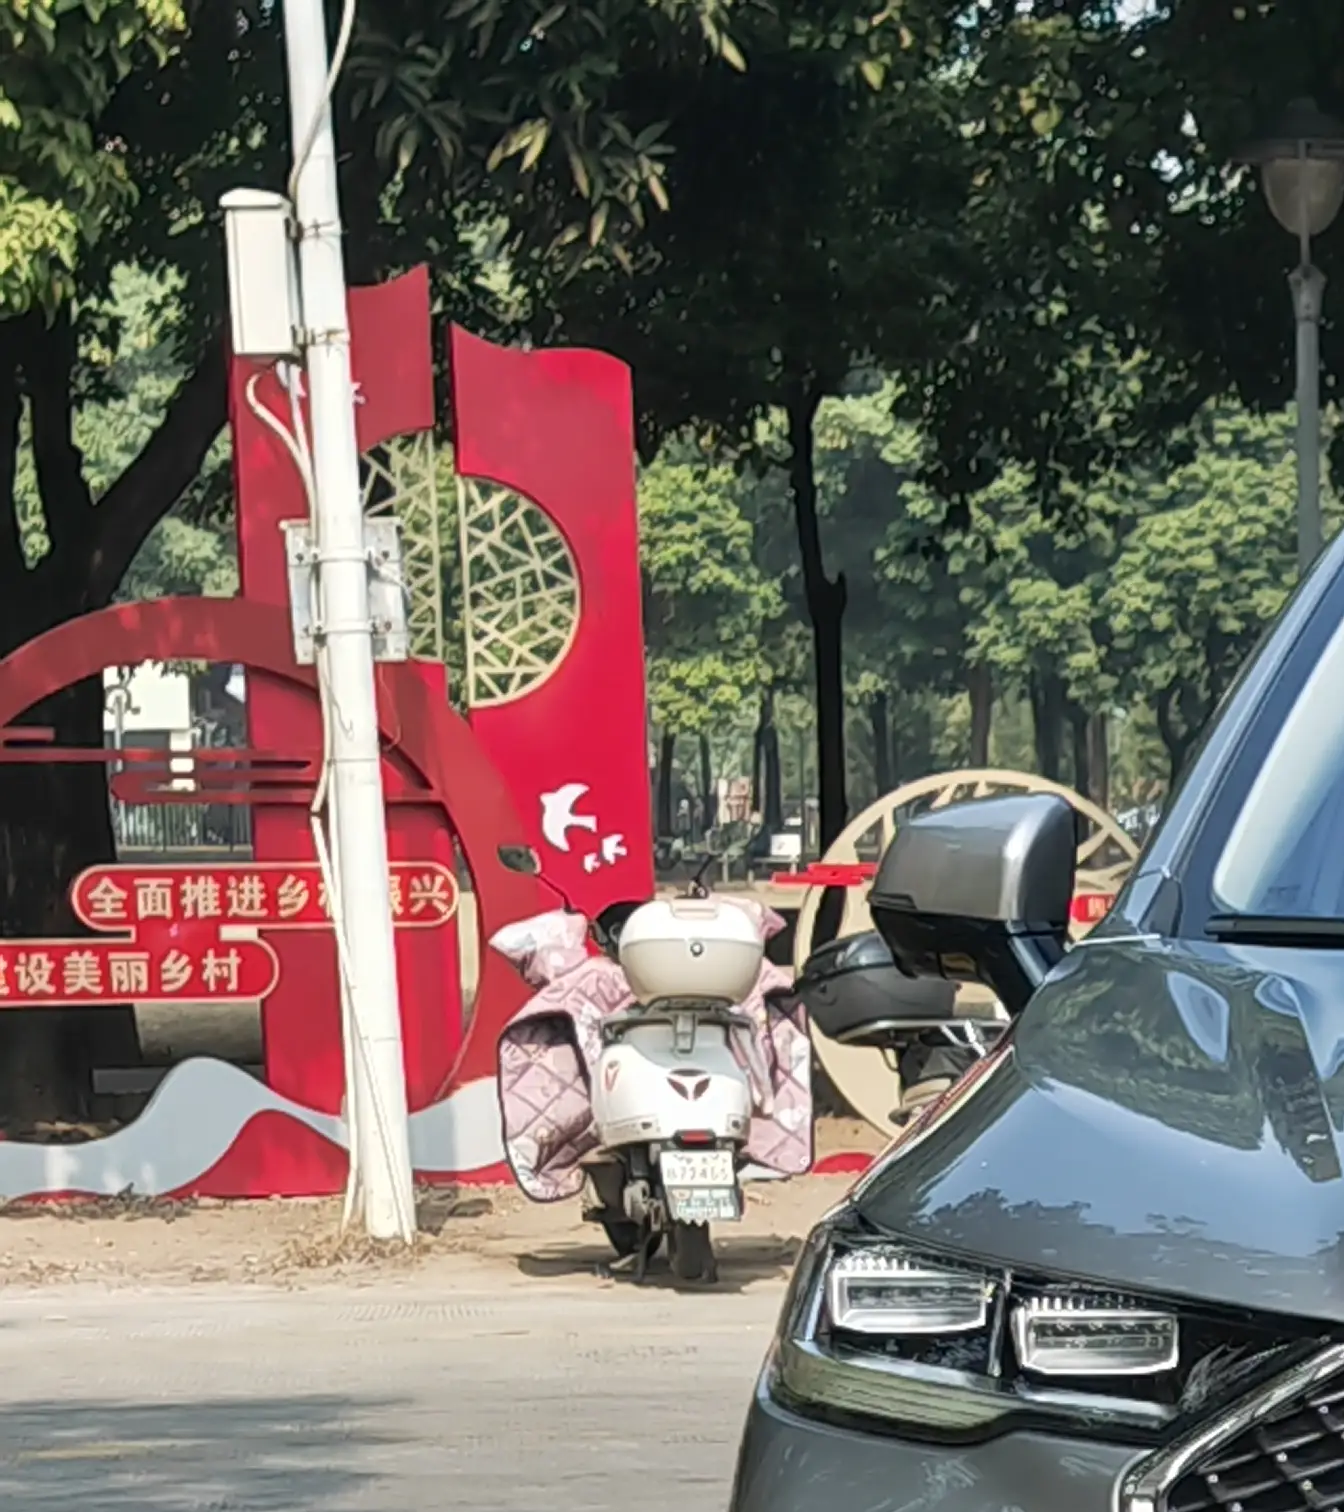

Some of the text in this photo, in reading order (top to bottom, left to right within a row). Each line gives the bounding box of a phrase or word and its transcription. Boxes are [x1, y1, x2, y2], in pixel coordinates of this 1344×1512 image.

[0, 948, 242, 995] 设美丽乡村
